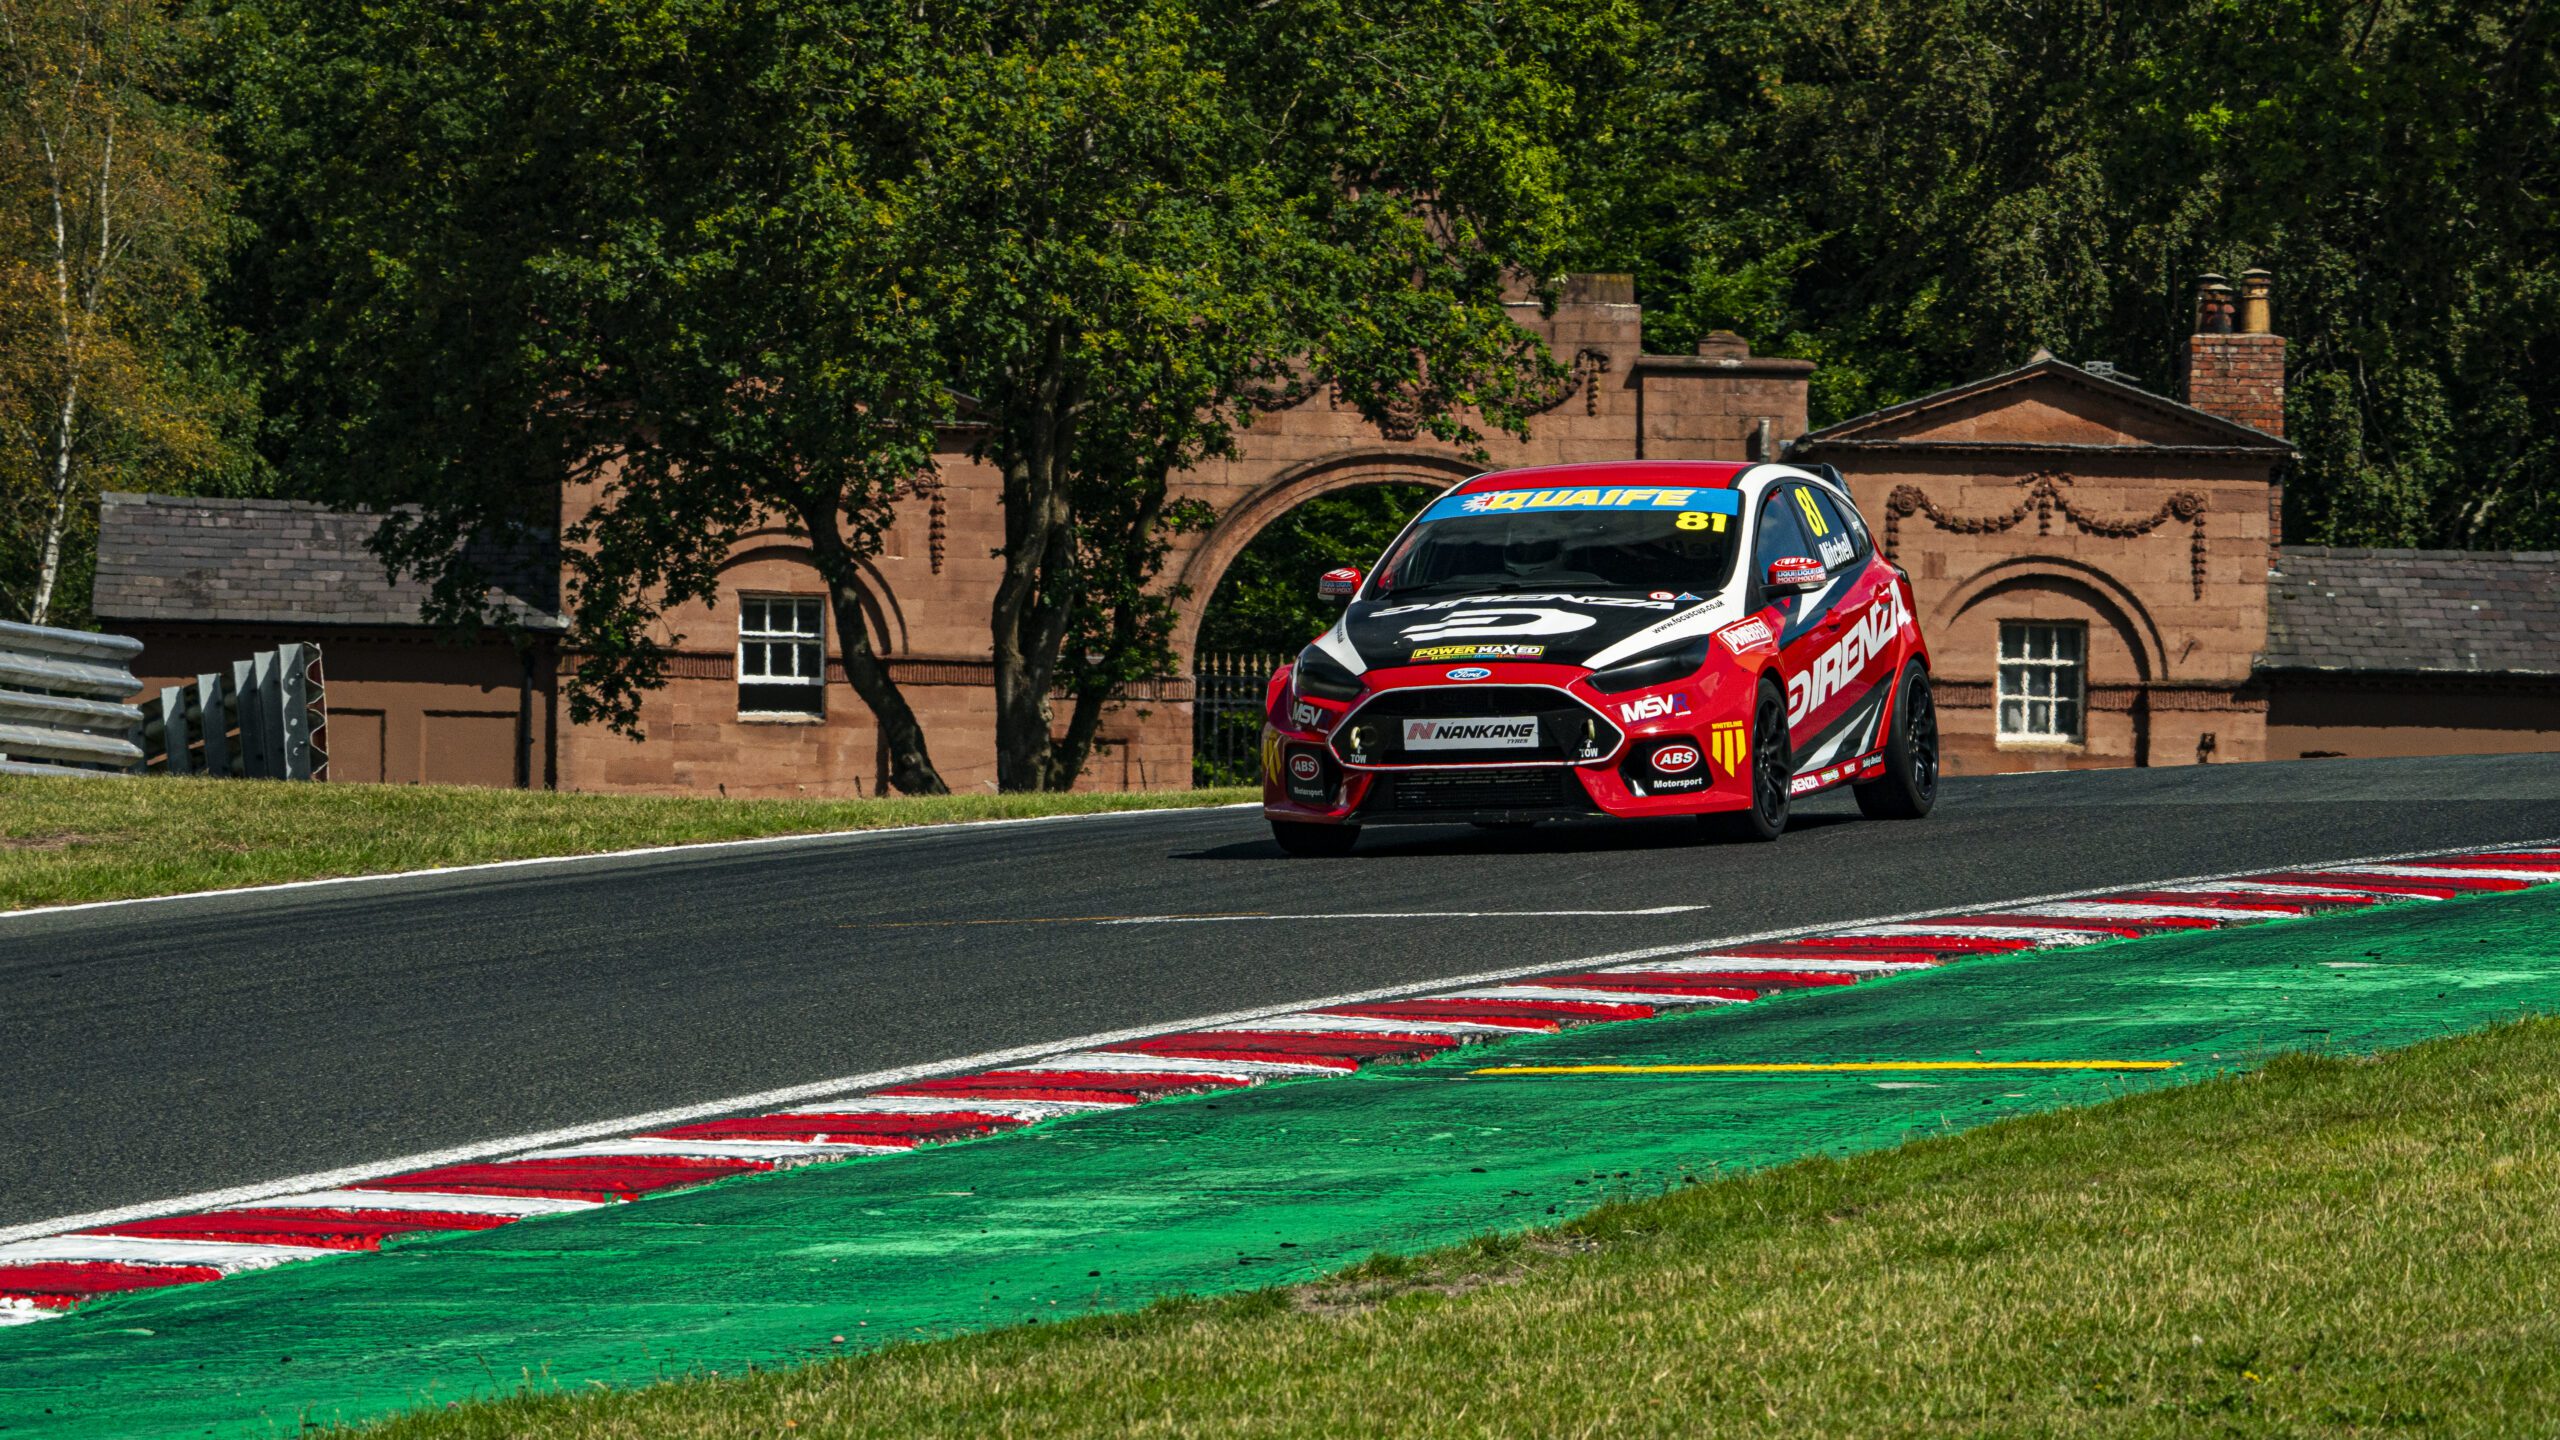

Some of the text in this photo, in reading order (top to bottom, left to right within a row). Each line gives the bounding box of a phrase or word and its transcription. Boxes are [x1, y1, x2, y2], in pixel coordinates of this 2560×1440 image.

[1488, 489, 1698, 510] QUAIFE
[1794, 486, 1829, 537] 81
[1675, 511, 1727, 533] 81
[1818, 532, 1855, 570] Mitchell
[1368, 594, 1675, 617] DIRENZA
[1652, 600, 1725, 634] www.focuscup.co.uk
[1416, 644, 1541, 657] POWER MAXED
[1787, 578, 1912, 729] DIRENZA
[1453, 670, 1482, 678] Ford
[1435, 723, 1535, 740] NANKANG
[1350, 753, 1367, 764] TOW
[1579, 748, 1599, 758] TOW
[1660, 752, 1693, 765] ABS
[1294, 760, 1315, 773] ABS
[1653, 777, 1703, 789] Motorsport
[1790, 774, 1820, 794] RENZA
